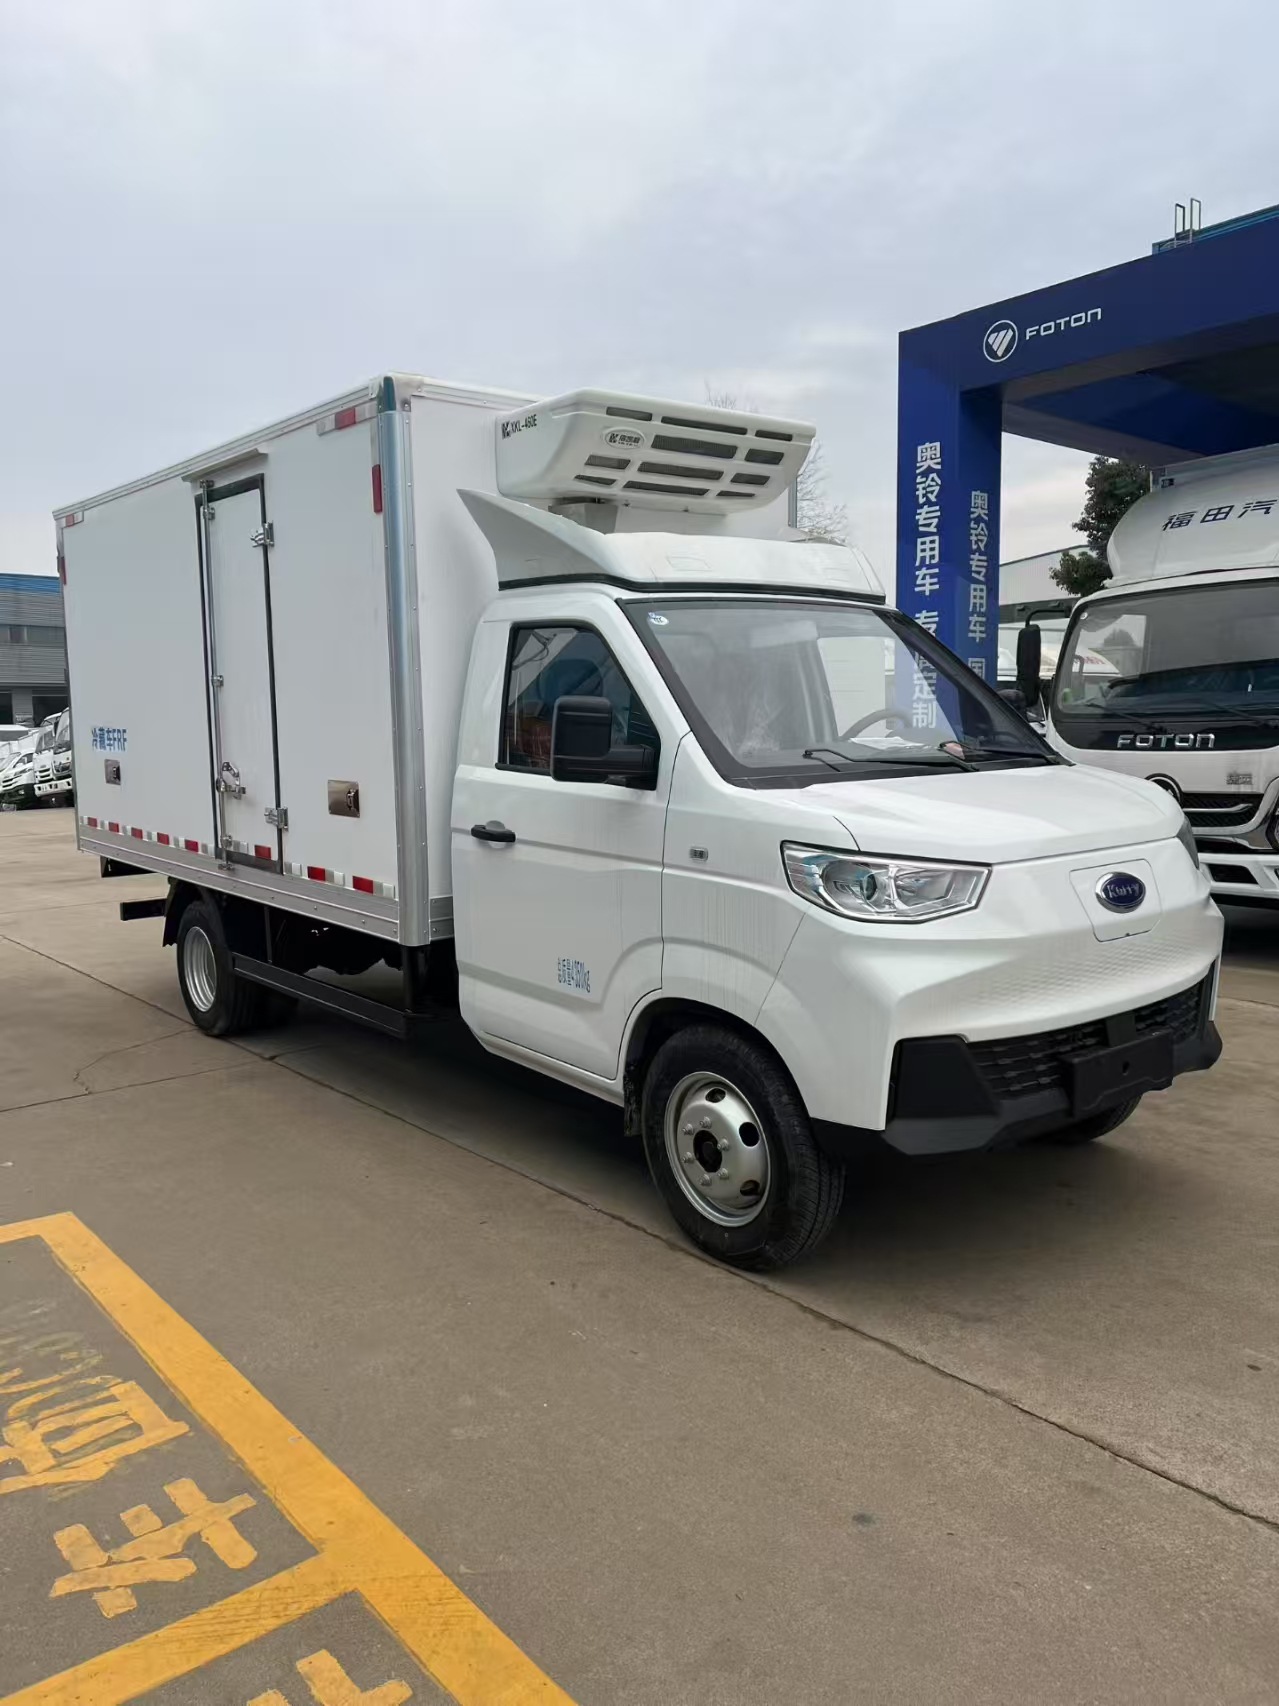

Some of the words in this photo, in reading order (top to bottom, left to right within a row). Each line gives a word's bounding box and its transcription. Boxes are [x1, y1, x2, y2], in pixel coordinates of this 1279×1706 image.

[1026, 307, 1102, 341] FOTON
[914, 441, 942, 596] 奥铃专用车
[1161, 499, 1278, 532] 福田汽
[968, 490, 989, 643] 奥铃专用车
[1116, 733, 1216, 748] FOTON
